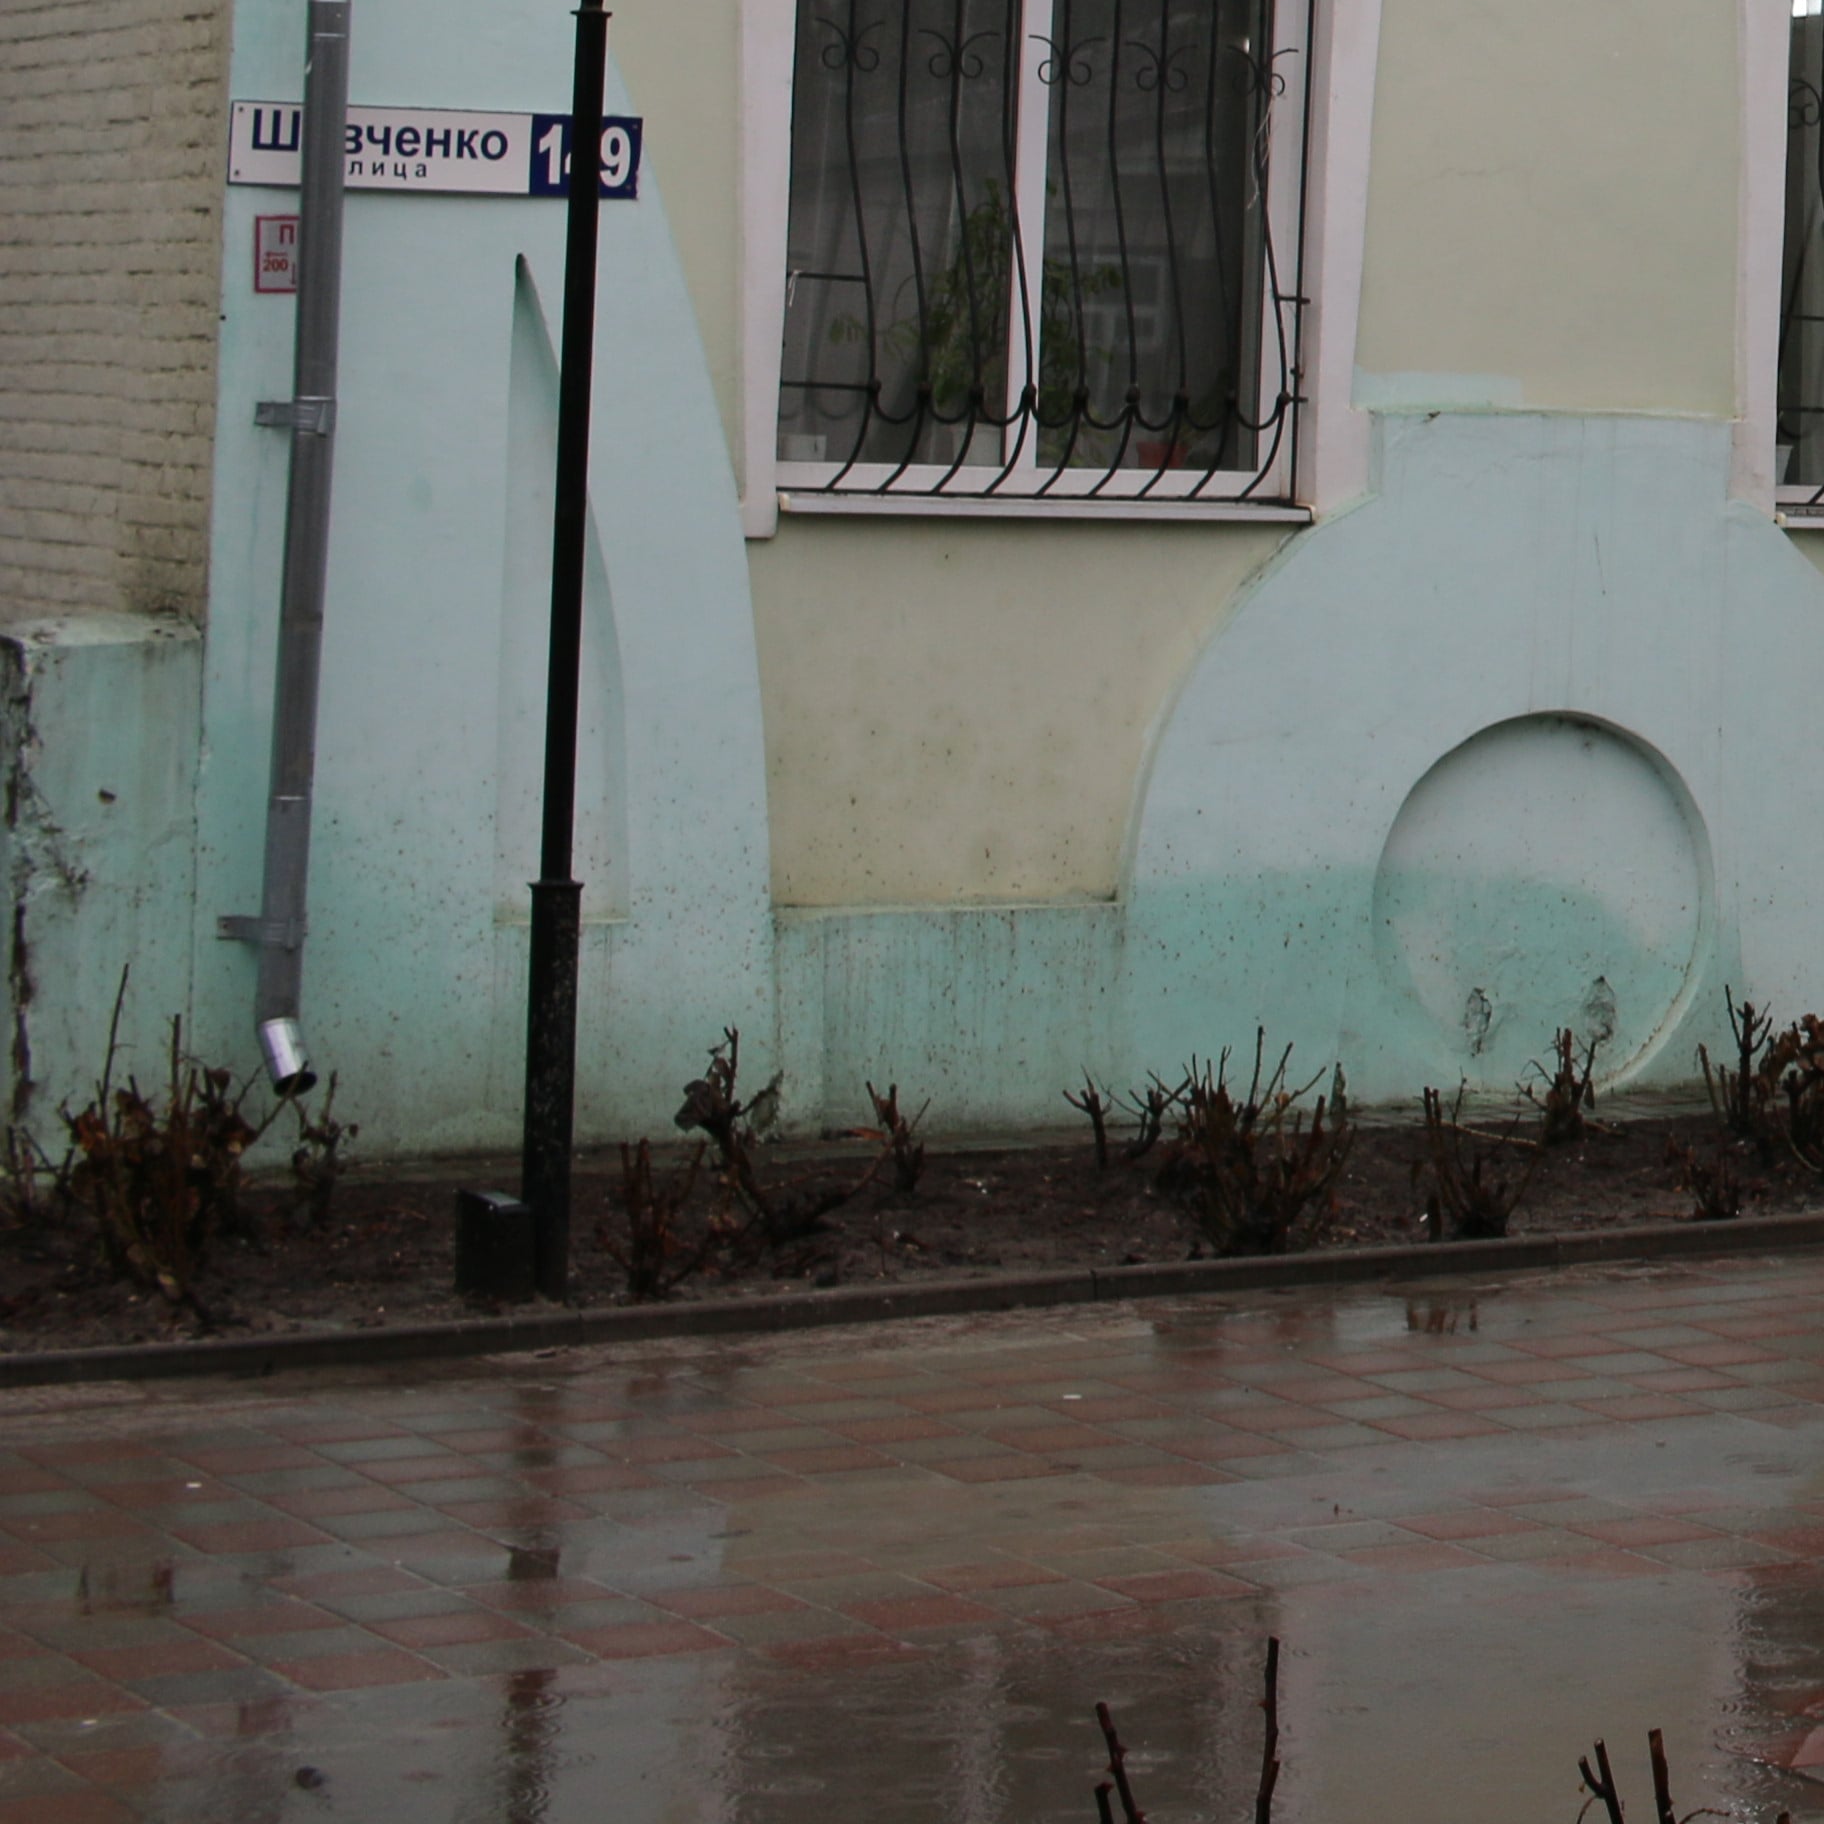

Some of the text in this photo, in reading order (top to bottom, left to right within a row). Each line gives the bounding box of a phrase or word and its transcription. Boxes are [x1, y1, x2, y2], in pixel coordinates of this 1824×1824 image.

[252, 108, 508, 161] Швченко
[349, 161, 427, 180] лица
[539, 123, 631, 188] 19
[263, 259, 288, 272] 200
